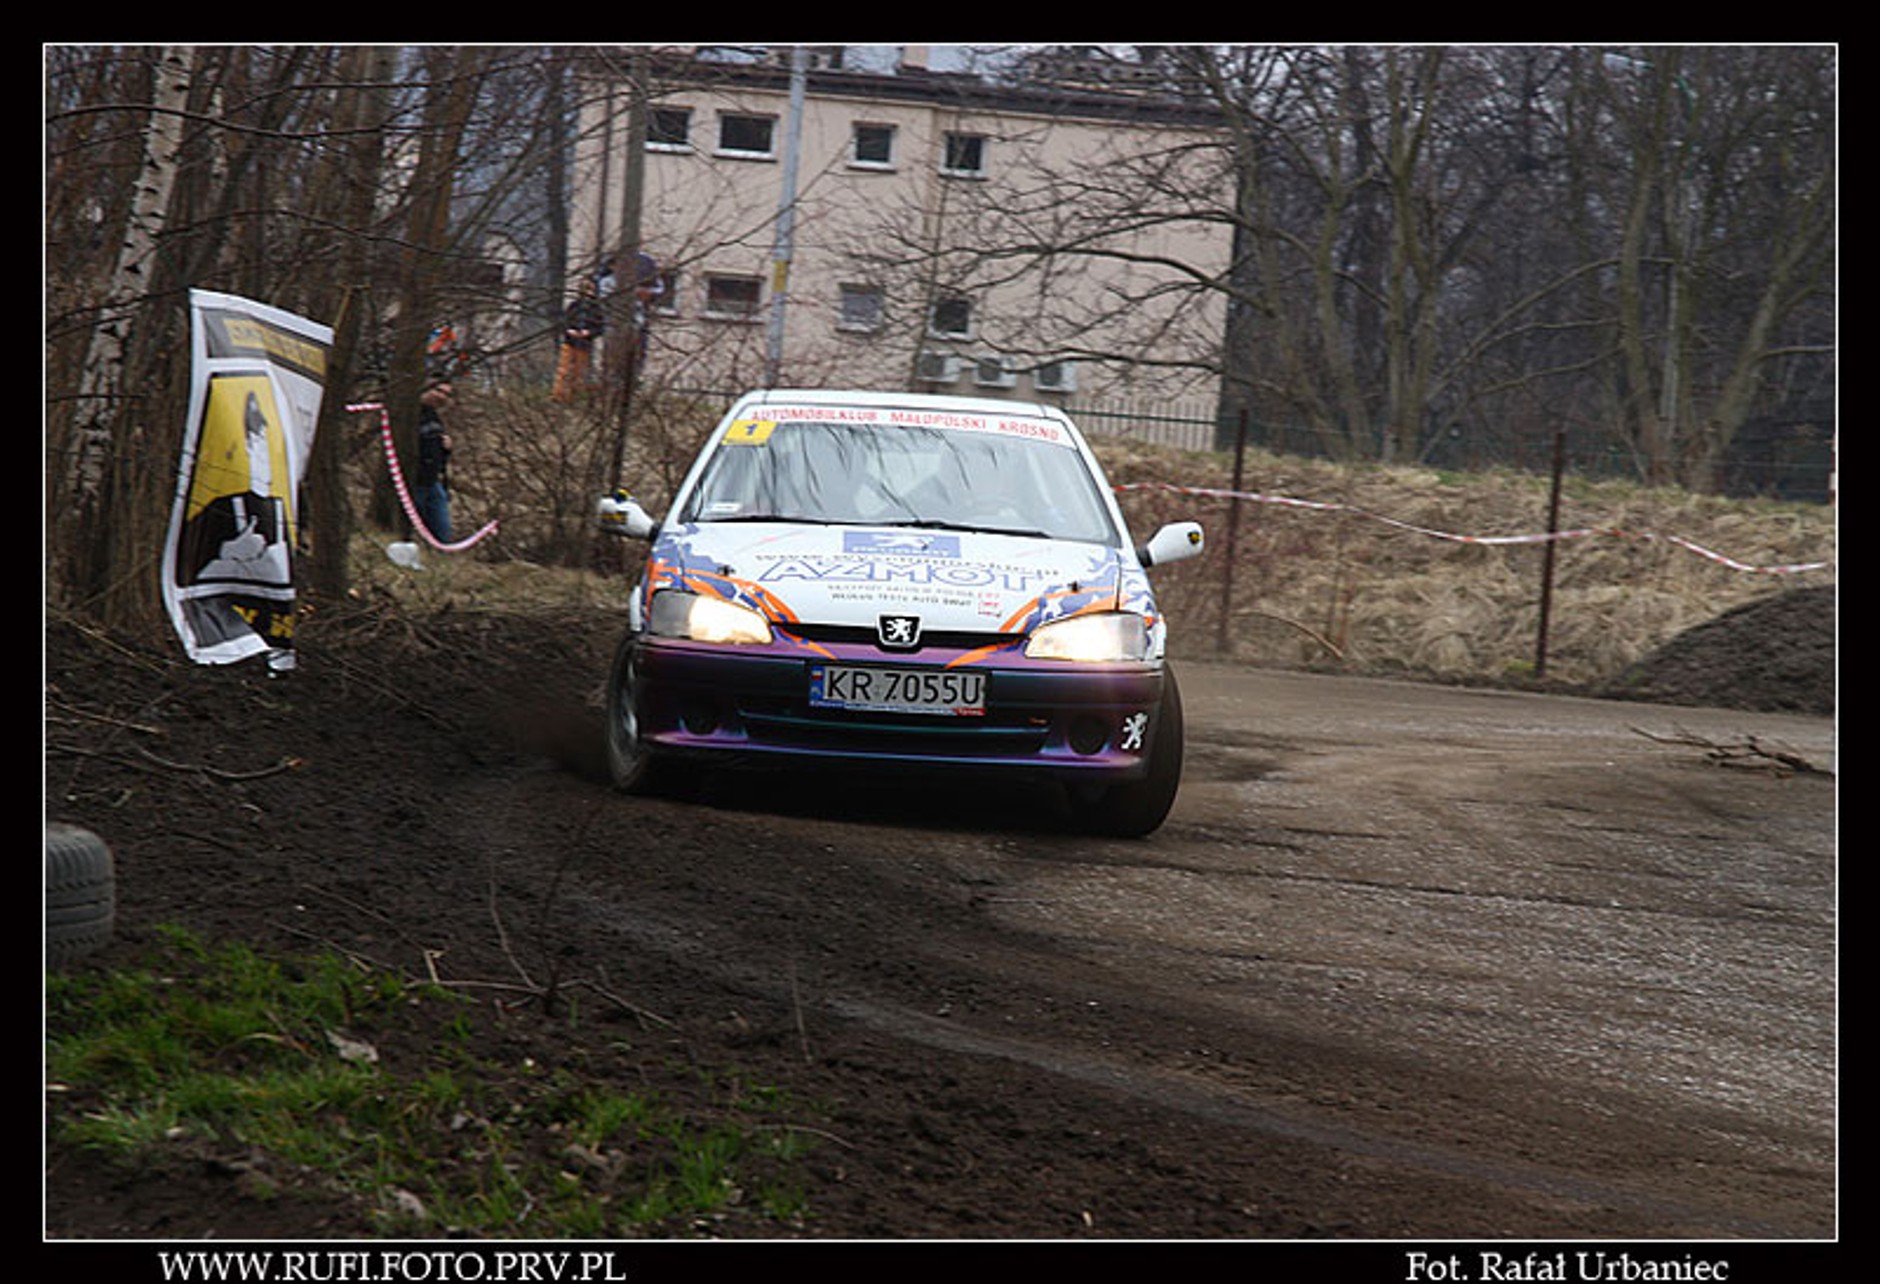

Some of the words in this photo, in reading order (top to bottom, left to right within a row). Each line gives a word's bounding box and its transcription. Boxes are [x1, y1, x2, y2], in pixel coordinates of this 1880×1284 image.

[744, 423, 756, 436] 1
[751, 409, 878, 422] AUTOMOBILKLUB
[891, 411, 987, 429] MAŁOPOLSKI
[998, 420, 1060, 440] KROSNO
[757, 559, 1043, 591] AZMOT
[827, 670, 873, 700] KR
[884, 673, 981, 705] 7055U
